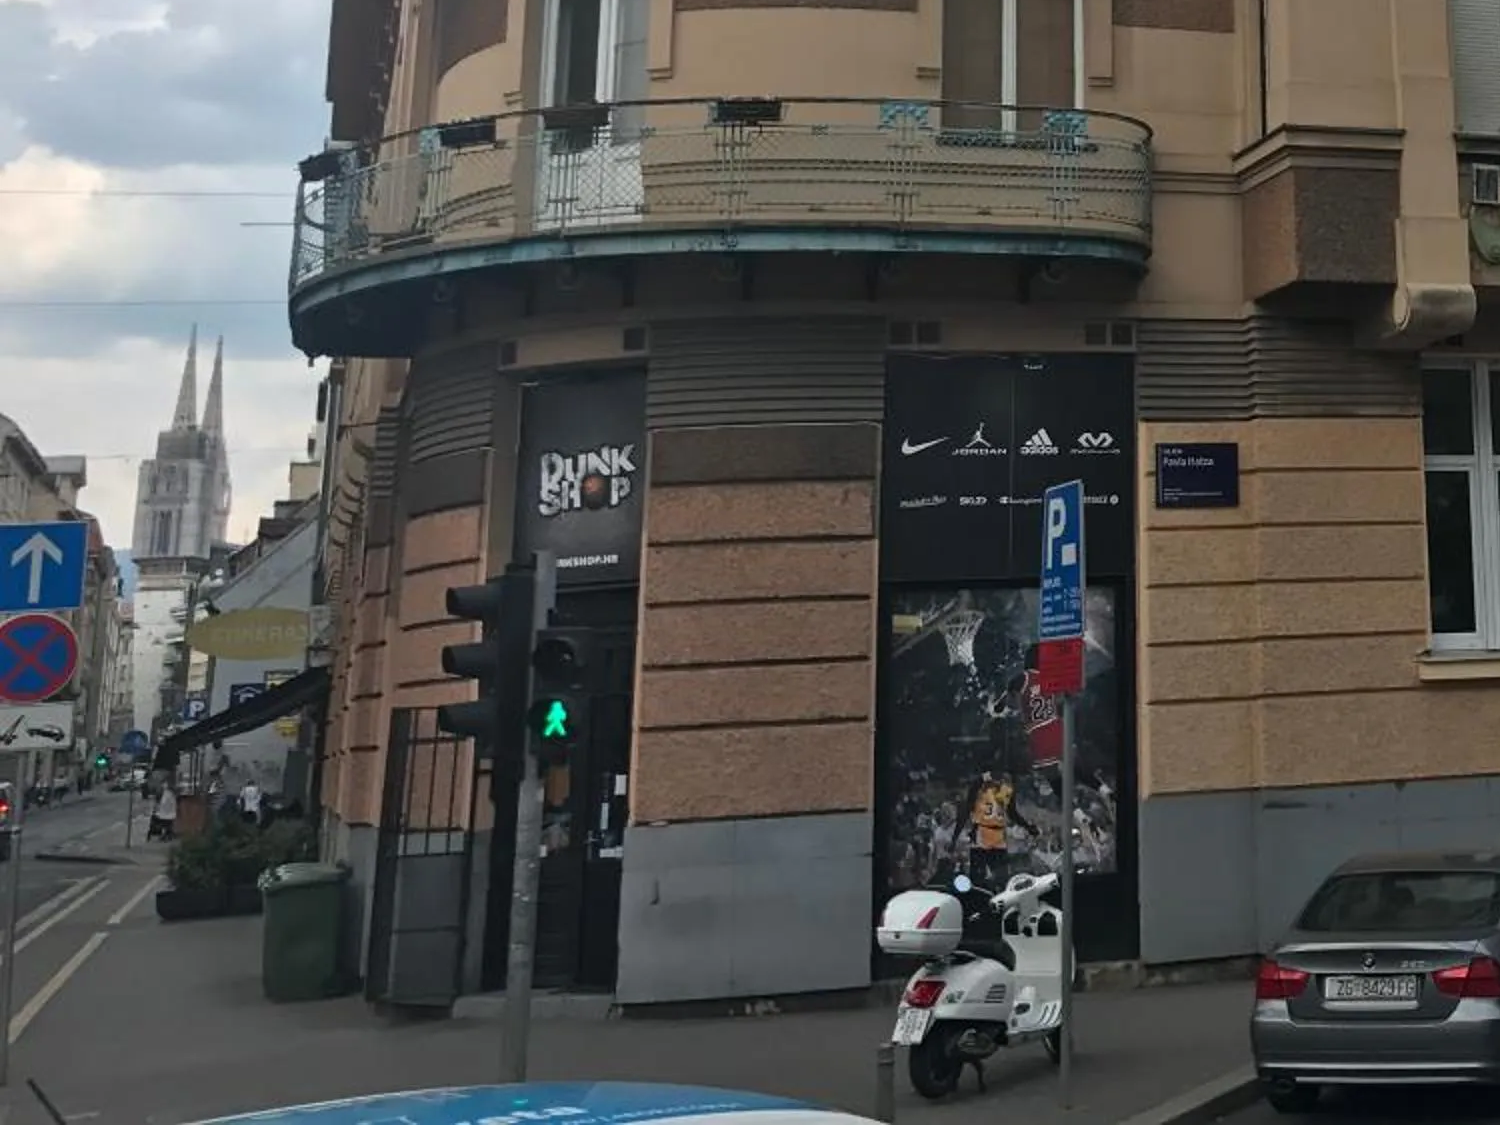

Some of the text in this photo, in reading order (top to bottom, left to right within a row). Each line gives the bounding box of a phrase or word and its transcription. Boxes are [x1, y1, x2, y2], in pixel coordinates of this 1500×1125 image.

[952, 447, 1007, 455] JORDAN
[1020, 446, 1059, 455] adidas
[541, 444, 636, 492] DUNK
[1047, 497, 1067, 570] P
[1337, 979, 1352, 996] ZG
